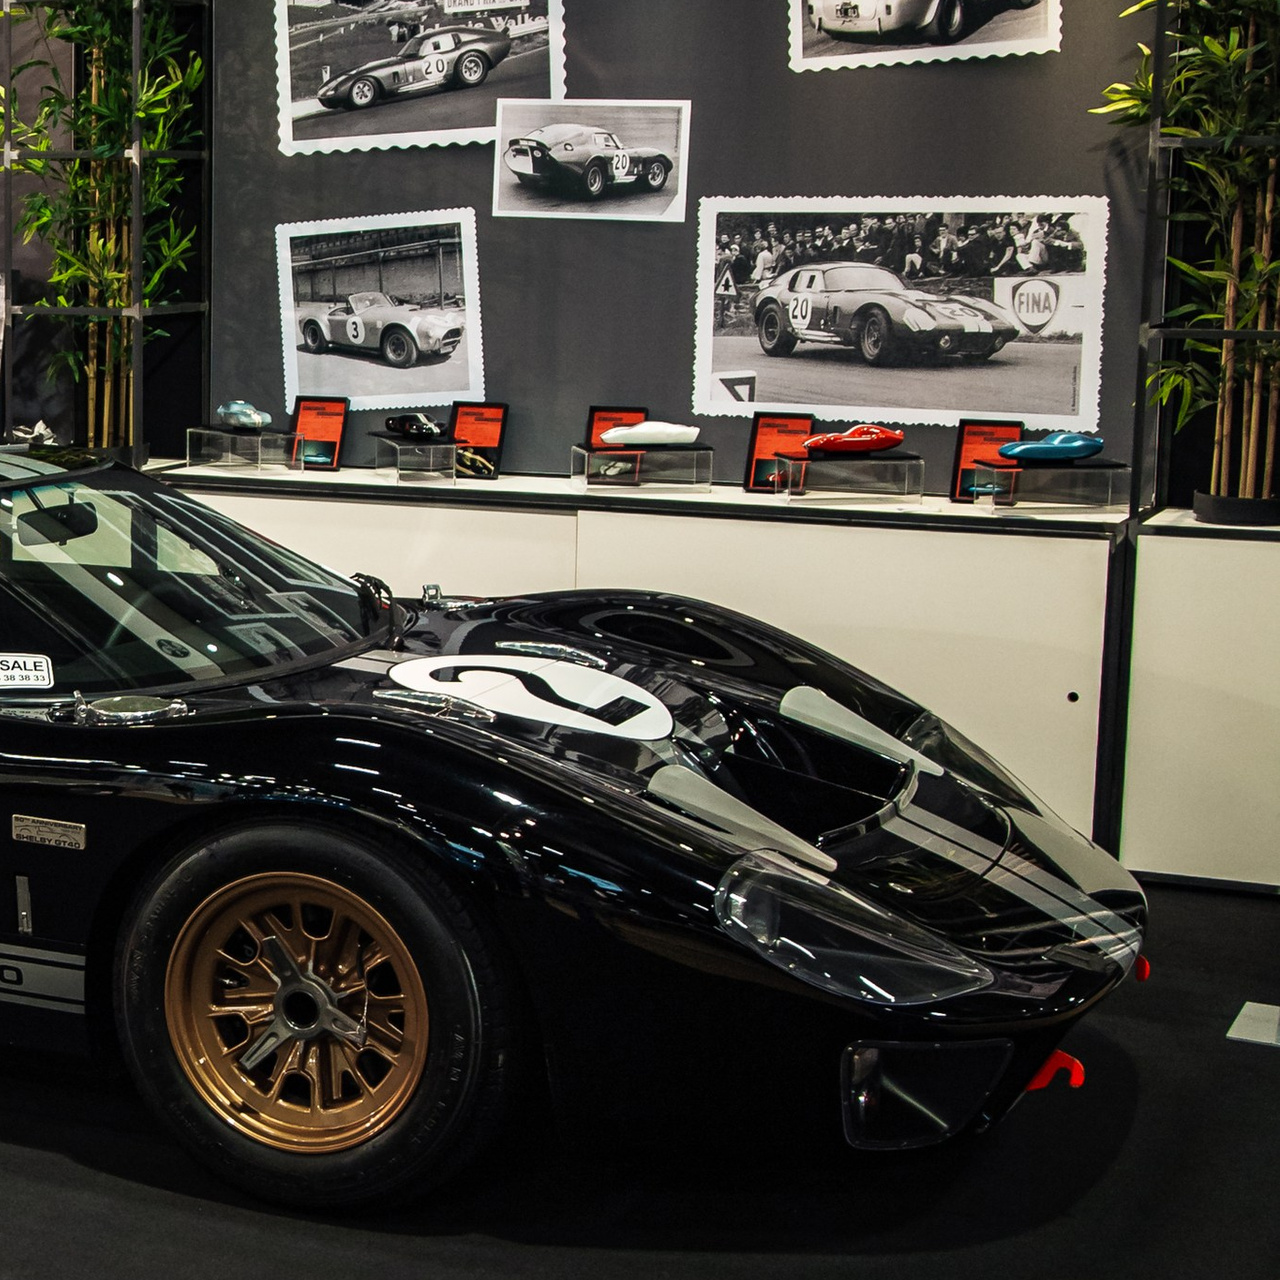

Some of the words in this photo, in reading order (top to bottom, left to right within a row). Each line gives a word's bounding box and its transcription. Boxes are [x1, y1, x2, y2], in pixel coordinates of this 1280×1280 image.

[490, 13, 549, 32] Walke
[424, 59, 445, 75] 20
[614, 154, 627, 170] 20
[791, 297, 809, 320] 20
[1018, 292, 1052, 313] FINA
[352, 322, 359, 339] 3
[0, 660, 44, 671] SALE
[428, 665, 651, 727] 2
[32, 819, 82, 830] ANNIVERSARY
[15, 833, 53, 844] SHELBY
[54, 839, 81, 849] GT40
